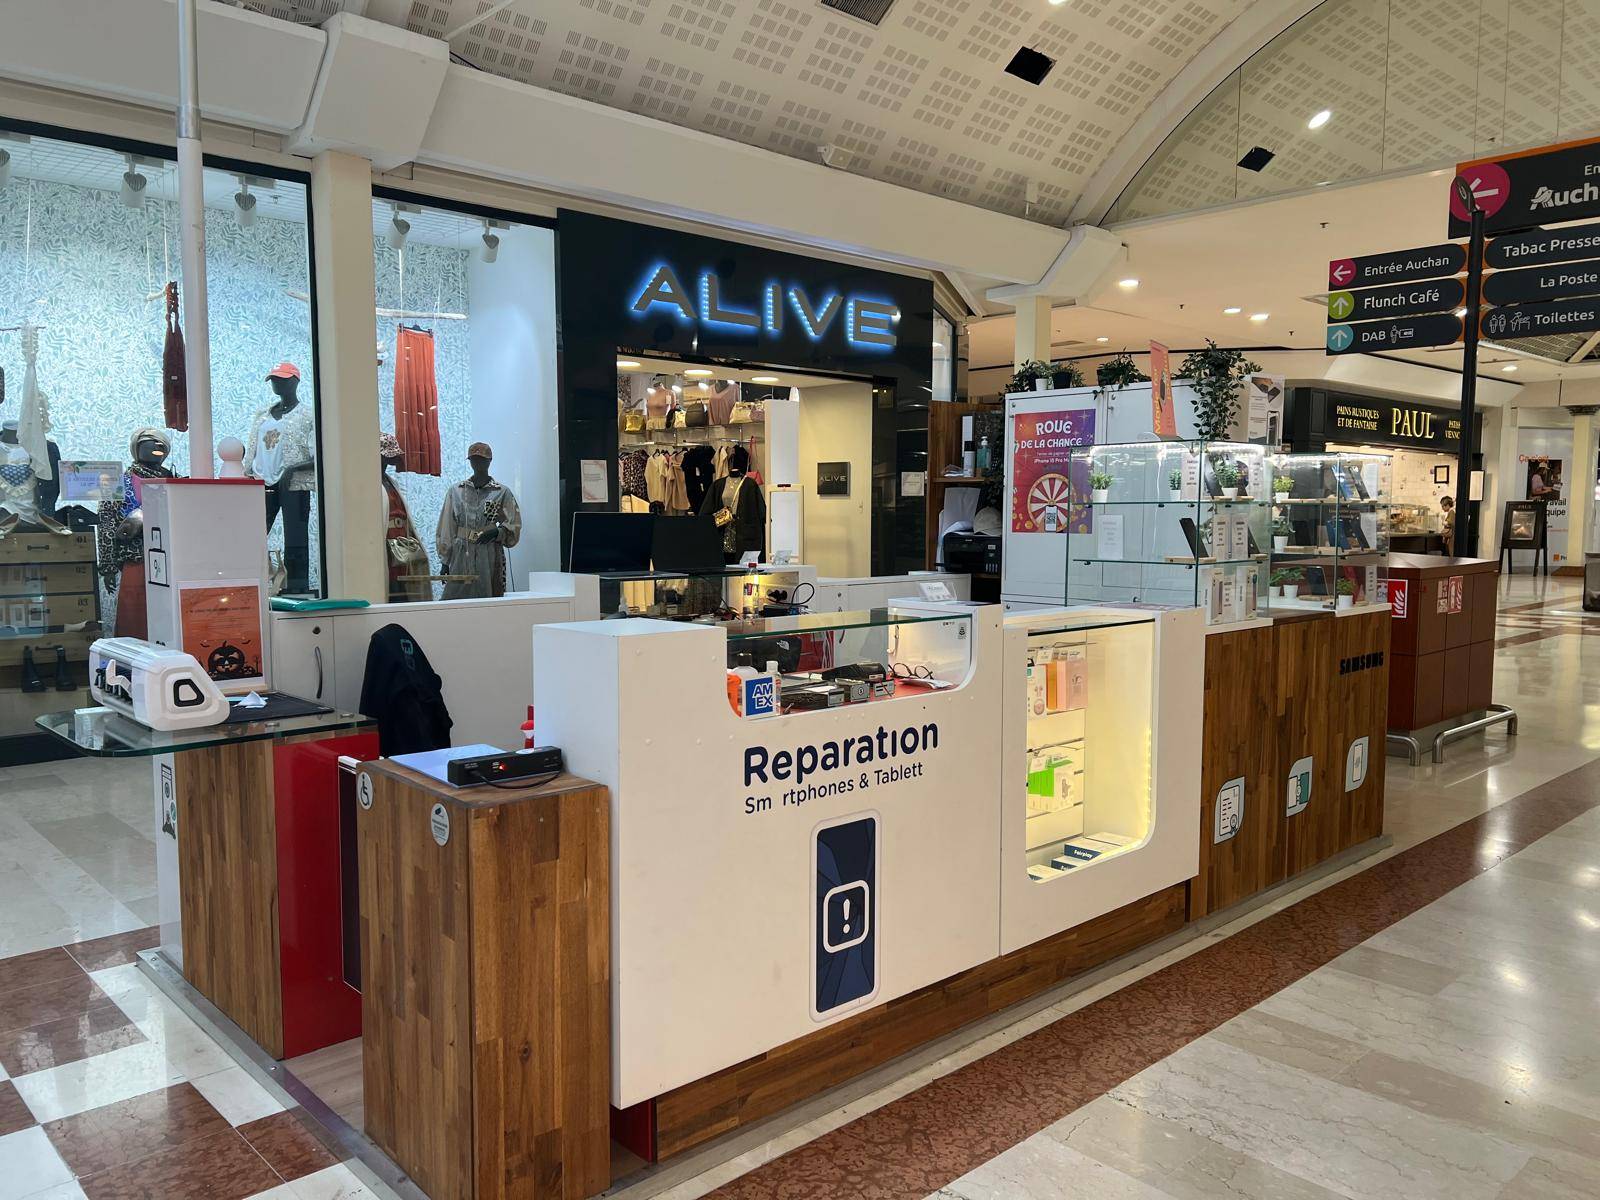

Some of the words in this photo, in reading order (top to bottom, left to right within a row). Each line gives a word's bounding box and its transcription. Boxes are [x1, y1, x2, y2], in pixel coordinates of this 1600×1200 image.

[1585, 165, 1600, 175] En
[1530, 182, 1599, 210] Auch
[1504, 242, 1546, 257] Tabac
[1550, 236, 1600, 251] Presse
[1364, 262, 1402, 277] Entrée
[1405, 256, 1449, 271] Auchan
[1540, 276, 1556, 288] La
[1559, 272, 1598, 285] Poste
[632, 265, 899, 346] ALIVE
[1364, 293, 1405, 309] Flunch
[1409, 289, 1440, 304] Café
[1535, 309, 1595, 325] Toilettes
[1362, 330, 1386, 342] DAB
[1336, 405, 1352, 416] PAINS
[1352, 407, 1380, 420] RUSTIQUES
[1035, 420, 1073, 435] ROUE
[1337, 417, 1345, 427] ET
[1345, 418, 1353, 428] DE
[1353, 419, 1378, 430] FANTAISIE
[1390, 407, 1435, 439] PAUL
[1021, 439, 1033, 449] DE
[1034, 439, 1045, 448] LA
[1047, 437, 1083, 448] CHANCE
[1340, 651, 1384, 675] SAMSUNG
[859, 774, 870, 789] &
[874, 762, 923, 786] Tablett
